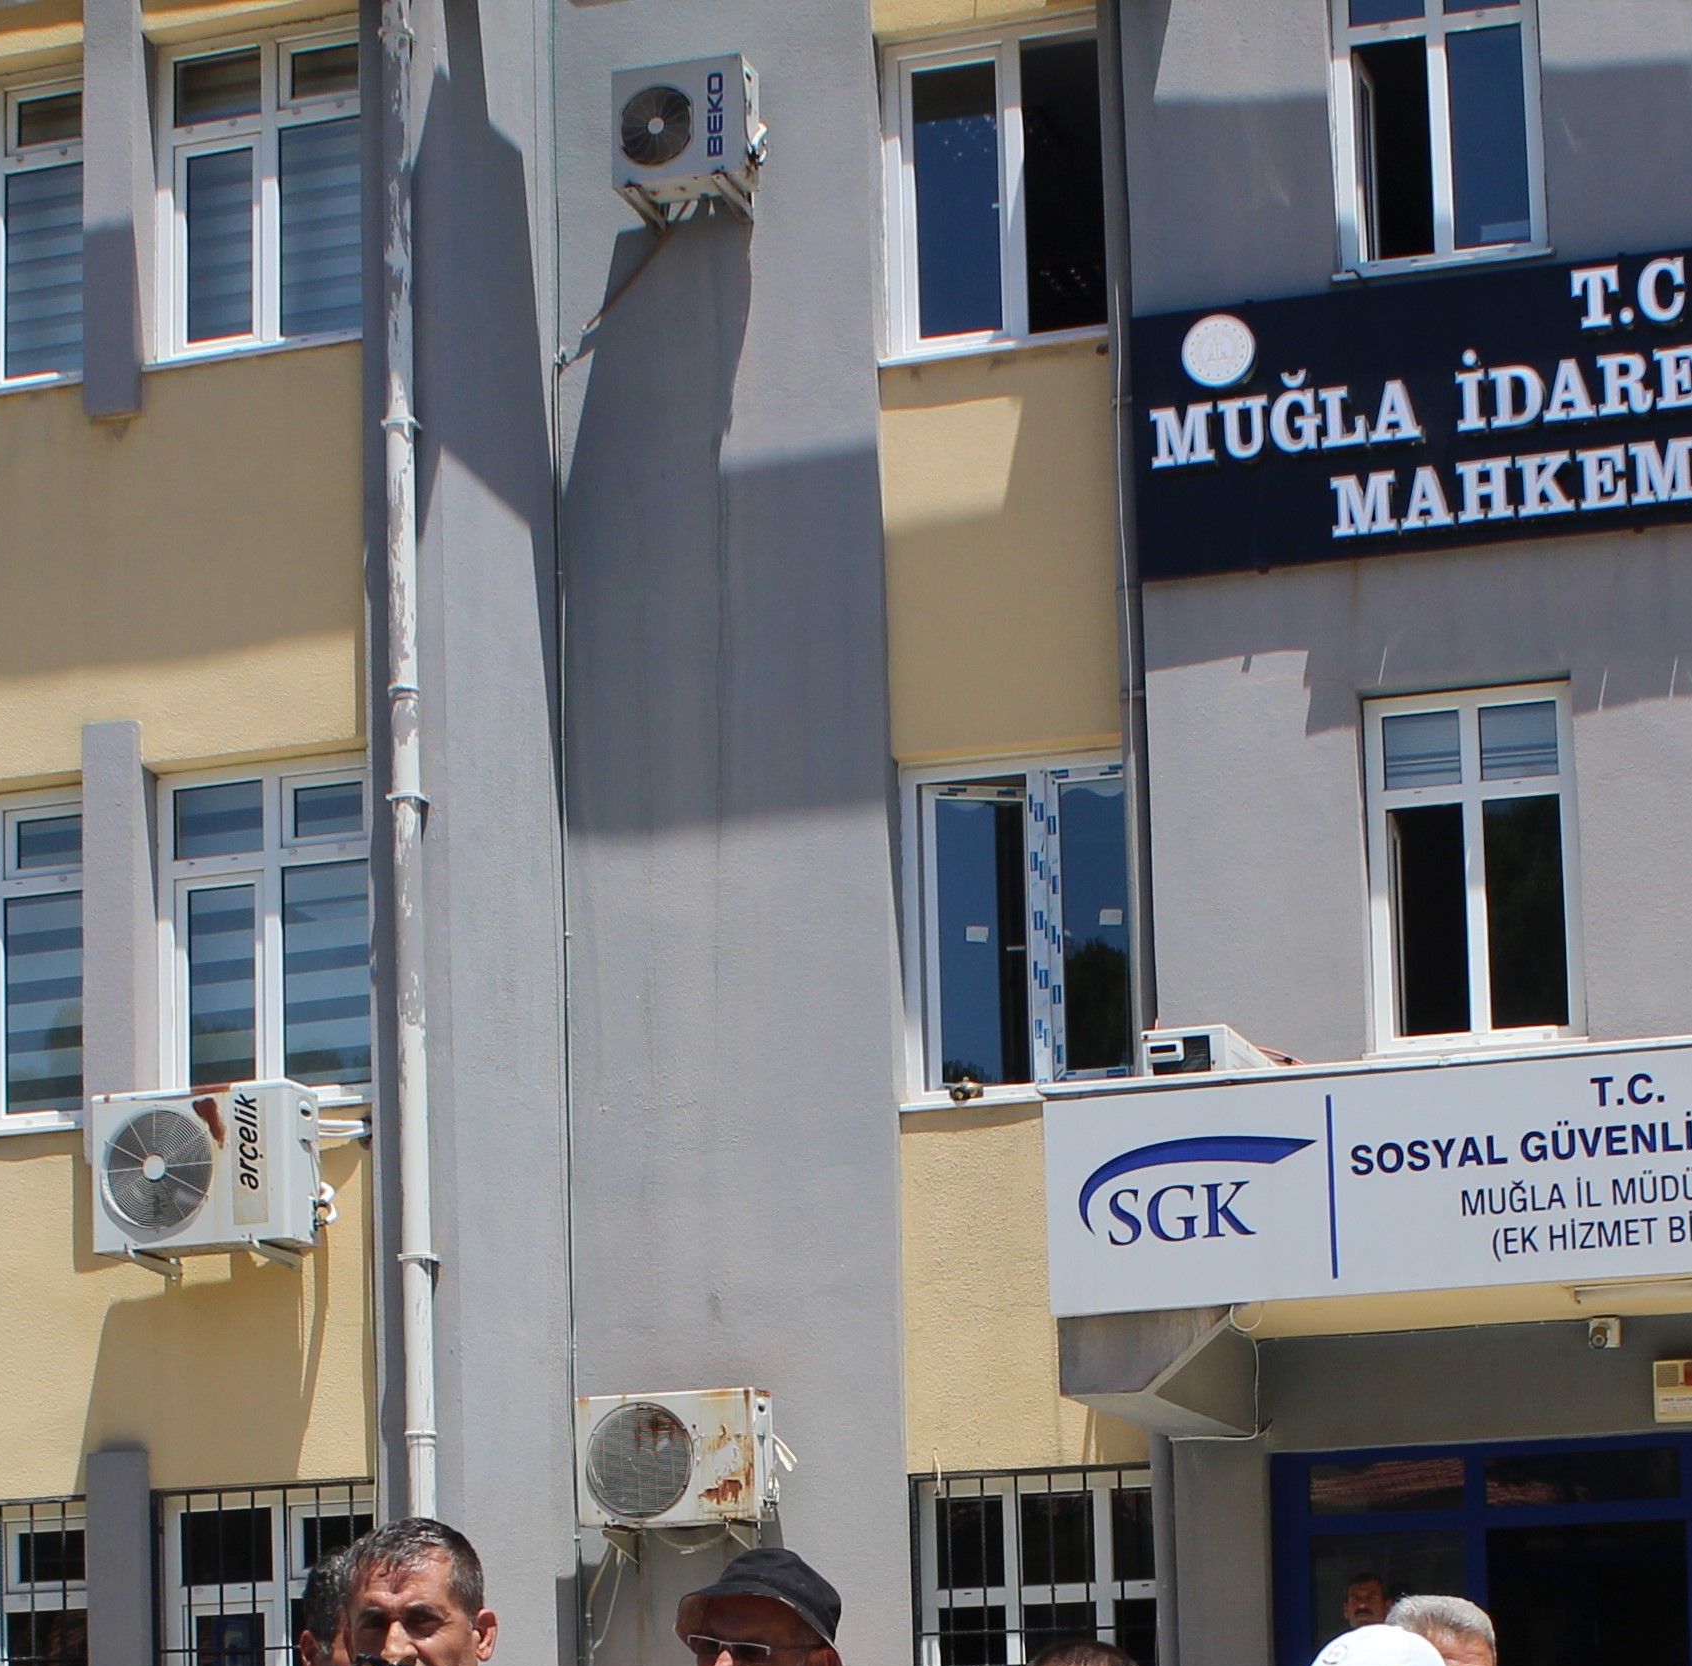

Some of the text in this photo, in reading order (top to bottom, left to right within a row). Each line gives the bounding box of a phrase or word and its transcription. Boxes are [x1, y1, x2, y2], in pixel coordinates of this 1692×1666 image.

[706, 71, 725, 158] BEKO
[1150, 371, 1426, 470] MUĞLA
[1589, 1073, 1665, 1107] T.C.
[233, 1093, 262, 1192] arçelik
[1350, 1134, 1509, 1176] SOSYAL
[1105, 1178, 1258, 1248] SGK
[1461, 1179, 1567, 1217] MUĞLA
[1576, 1176, 1602, 1208] İL
[1491, 1225, 1539, 1262] (EK
[1548, 1217, 1658, 1252] HİZMET
